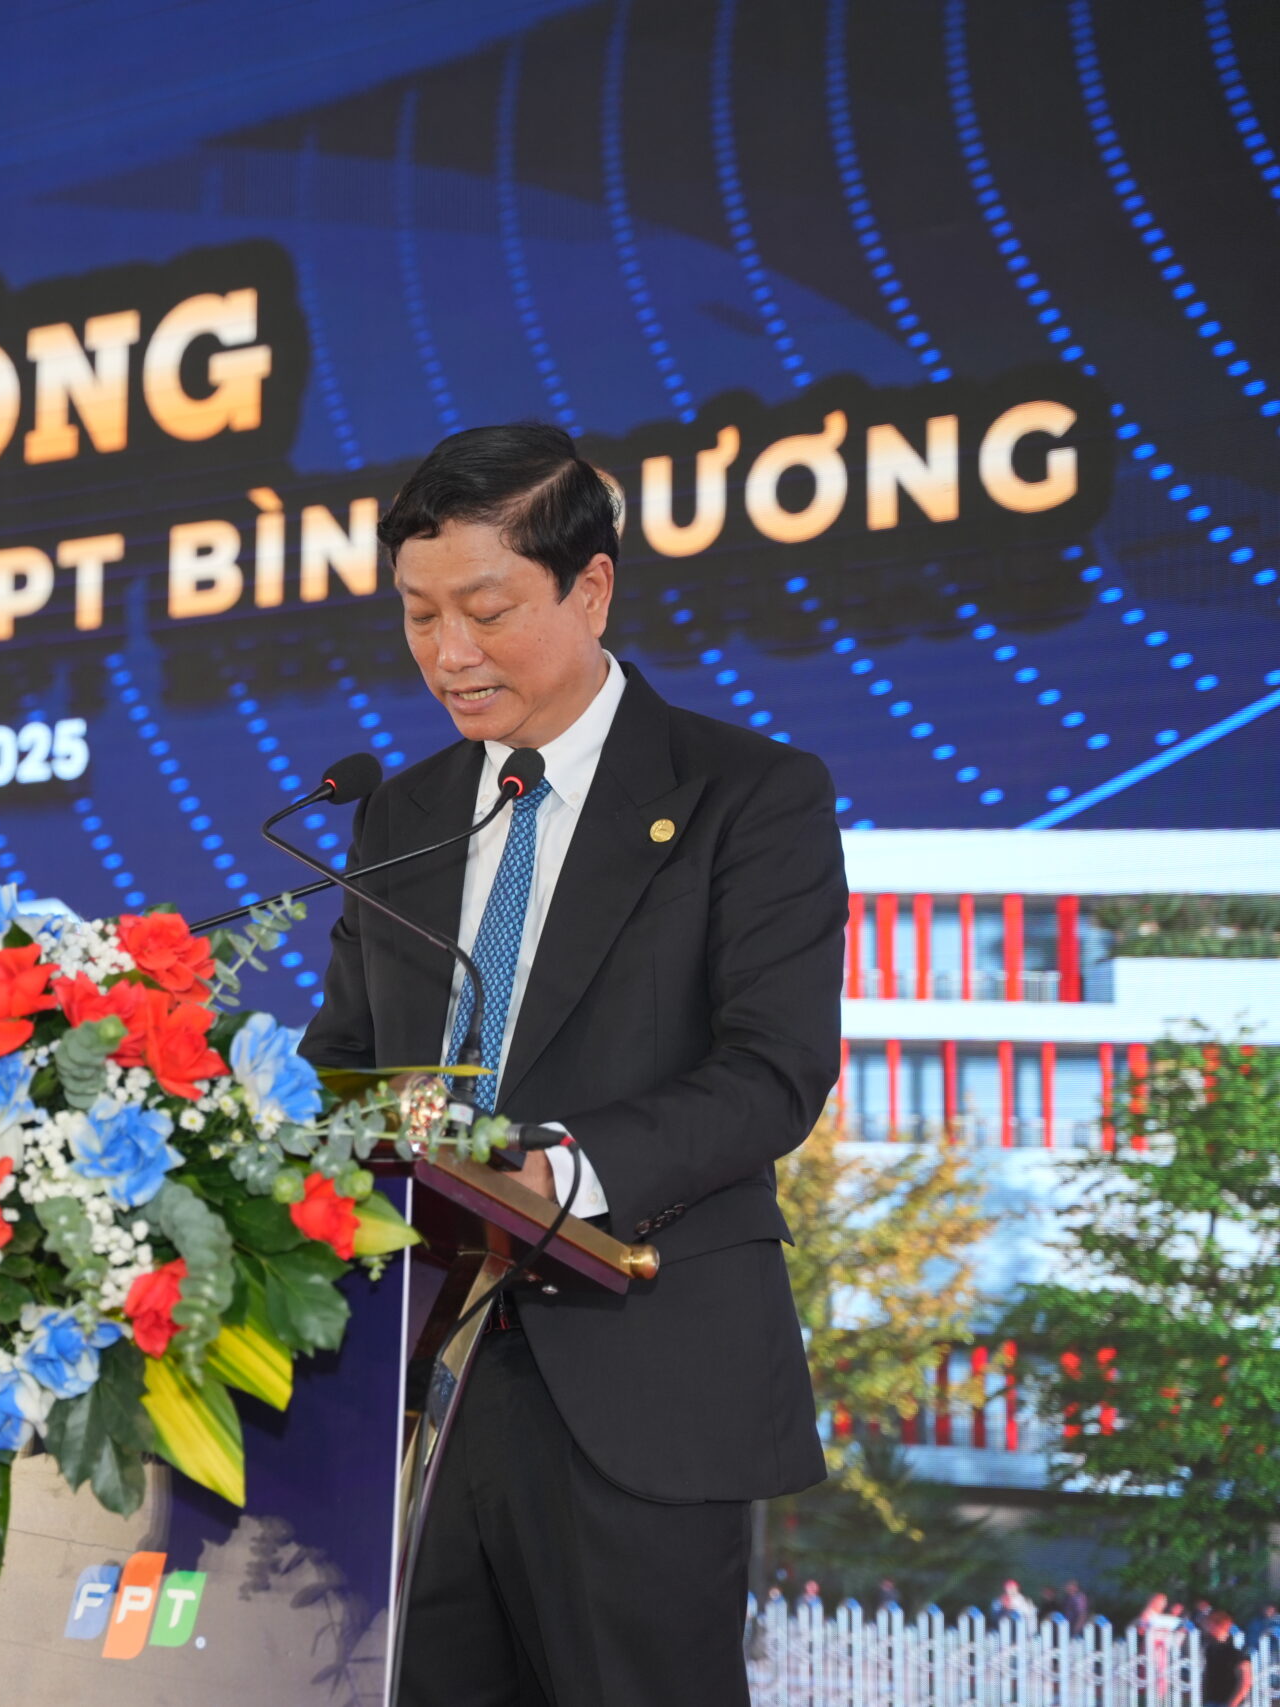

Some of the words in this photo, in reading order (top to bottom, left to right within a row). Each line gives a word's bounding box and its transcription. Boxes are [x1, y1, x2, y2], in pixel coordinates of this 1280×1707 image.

[167, 486, 399, 619] BÌN
[596, 400, 1078, 558] ƯƠNG
[74, 1583, 196, 1628] FPT
